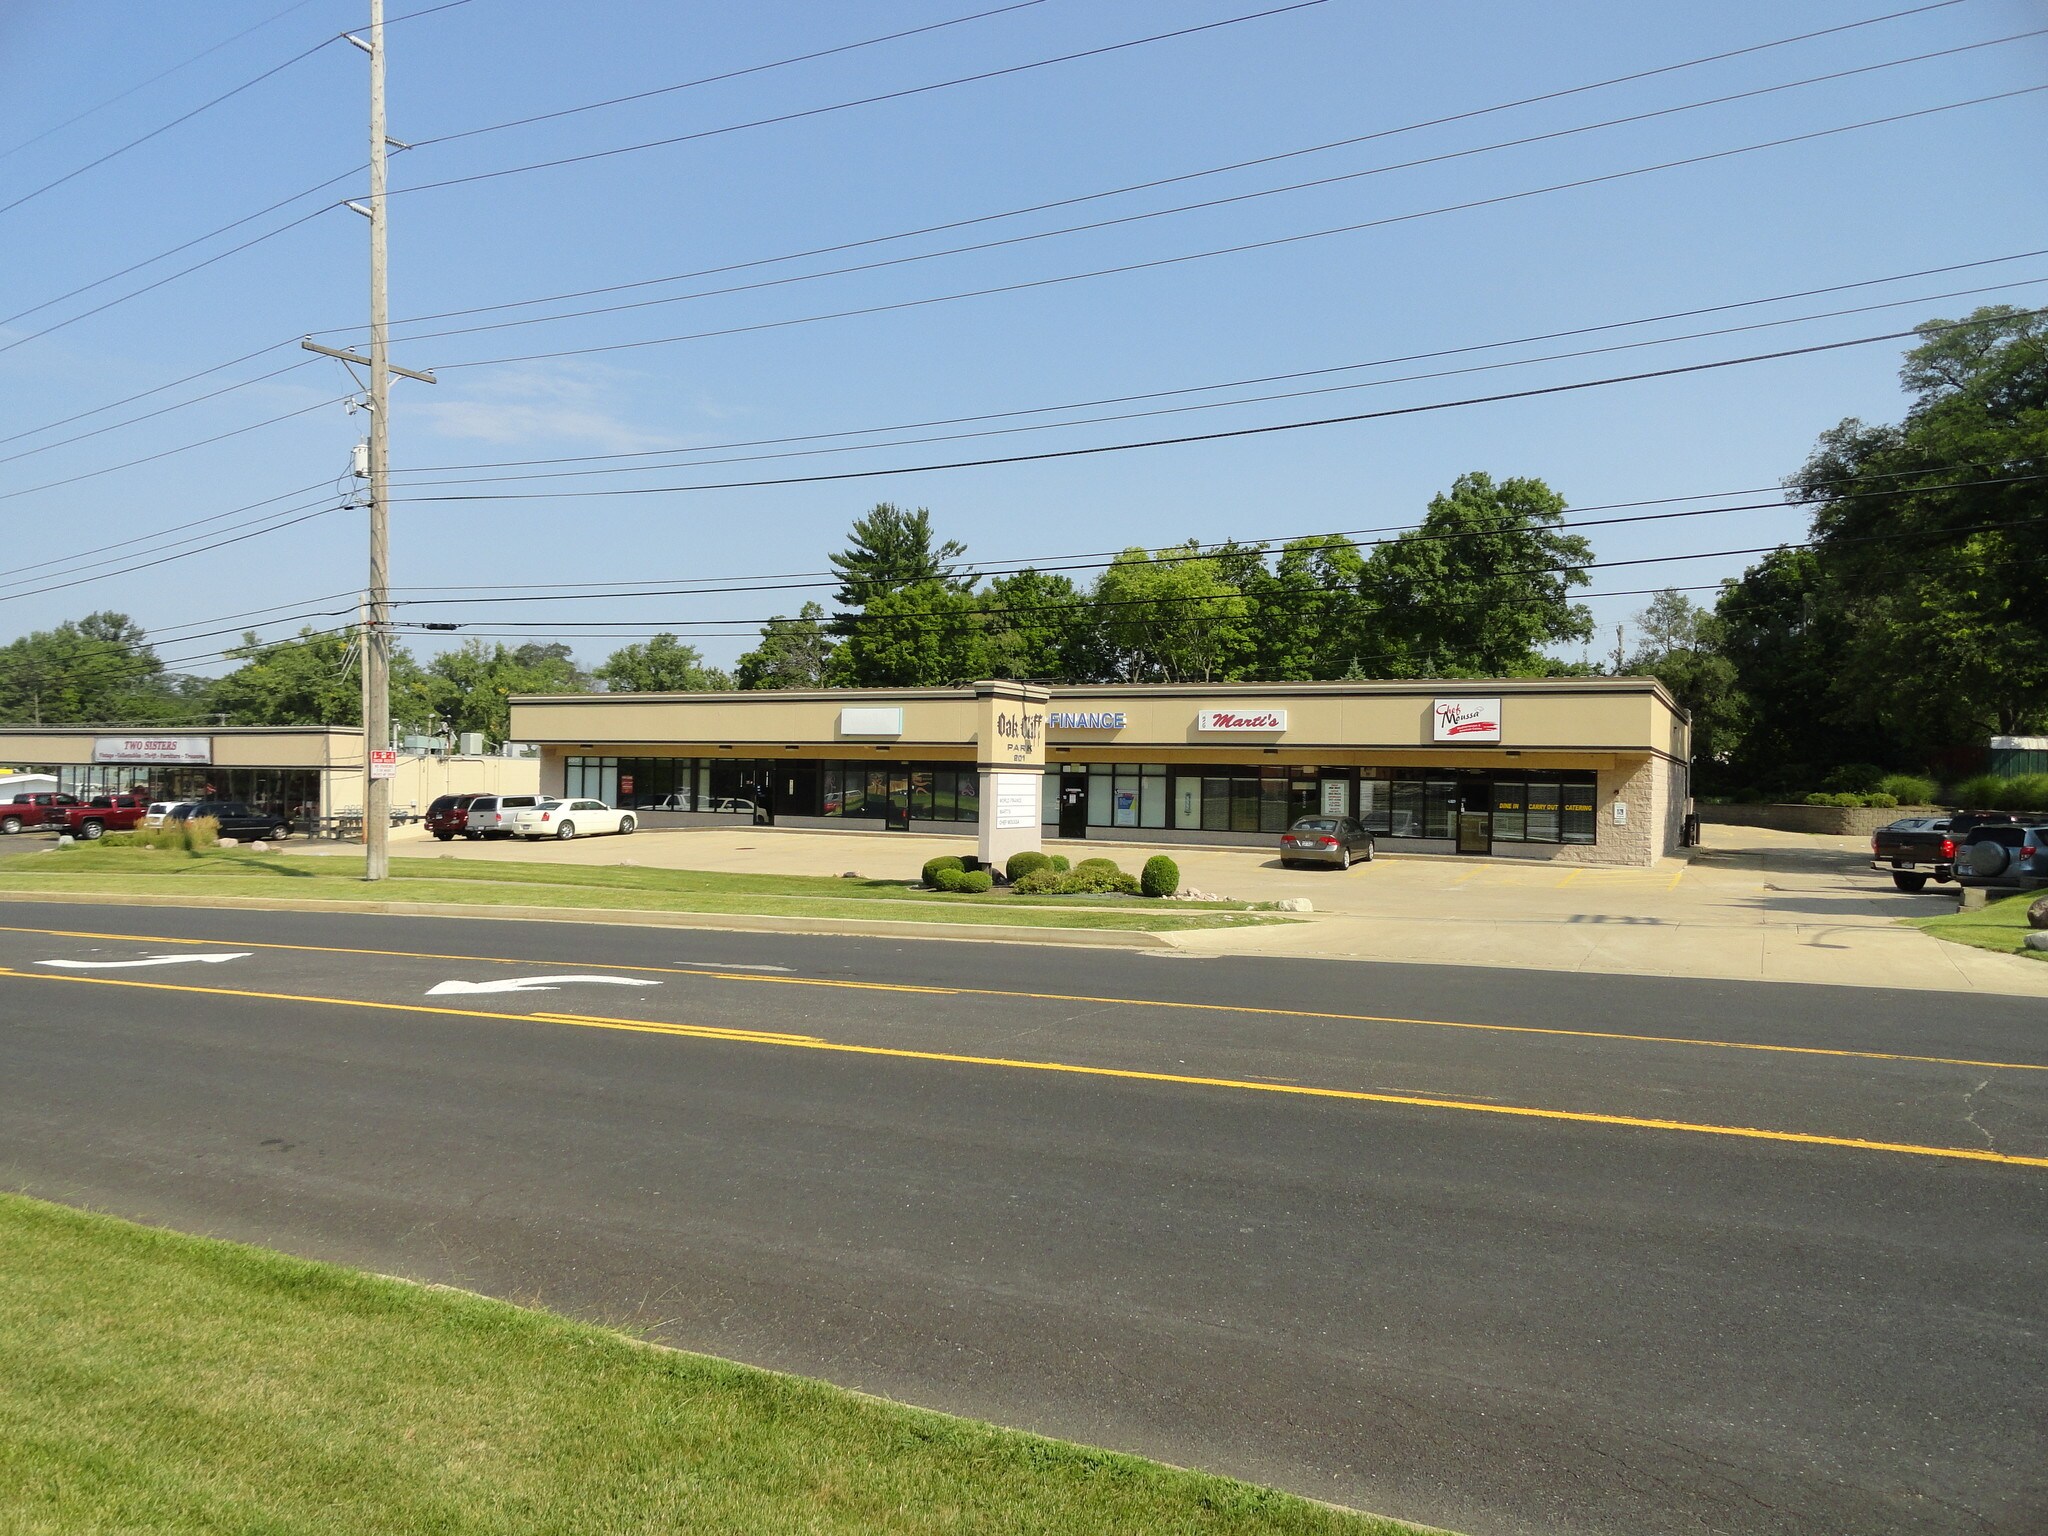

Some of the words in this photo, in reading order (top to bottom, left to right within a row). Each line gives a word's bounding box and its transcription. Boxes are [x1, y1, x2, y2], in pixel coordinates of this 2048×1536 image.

[1436, 703, 1461, 716] Chef
[997, 712, 1019, 738] Oak
[1050, 712, 1126, 729] FINANCE
[1213, 713, 1279, 728] Marti's
[1442, 711, 1480, 729] Moussa
[124, 741, 143, 750] TWO
[144, 741, 178, 751] SISTERS
[1007, 744, 1032, 752] PARK
